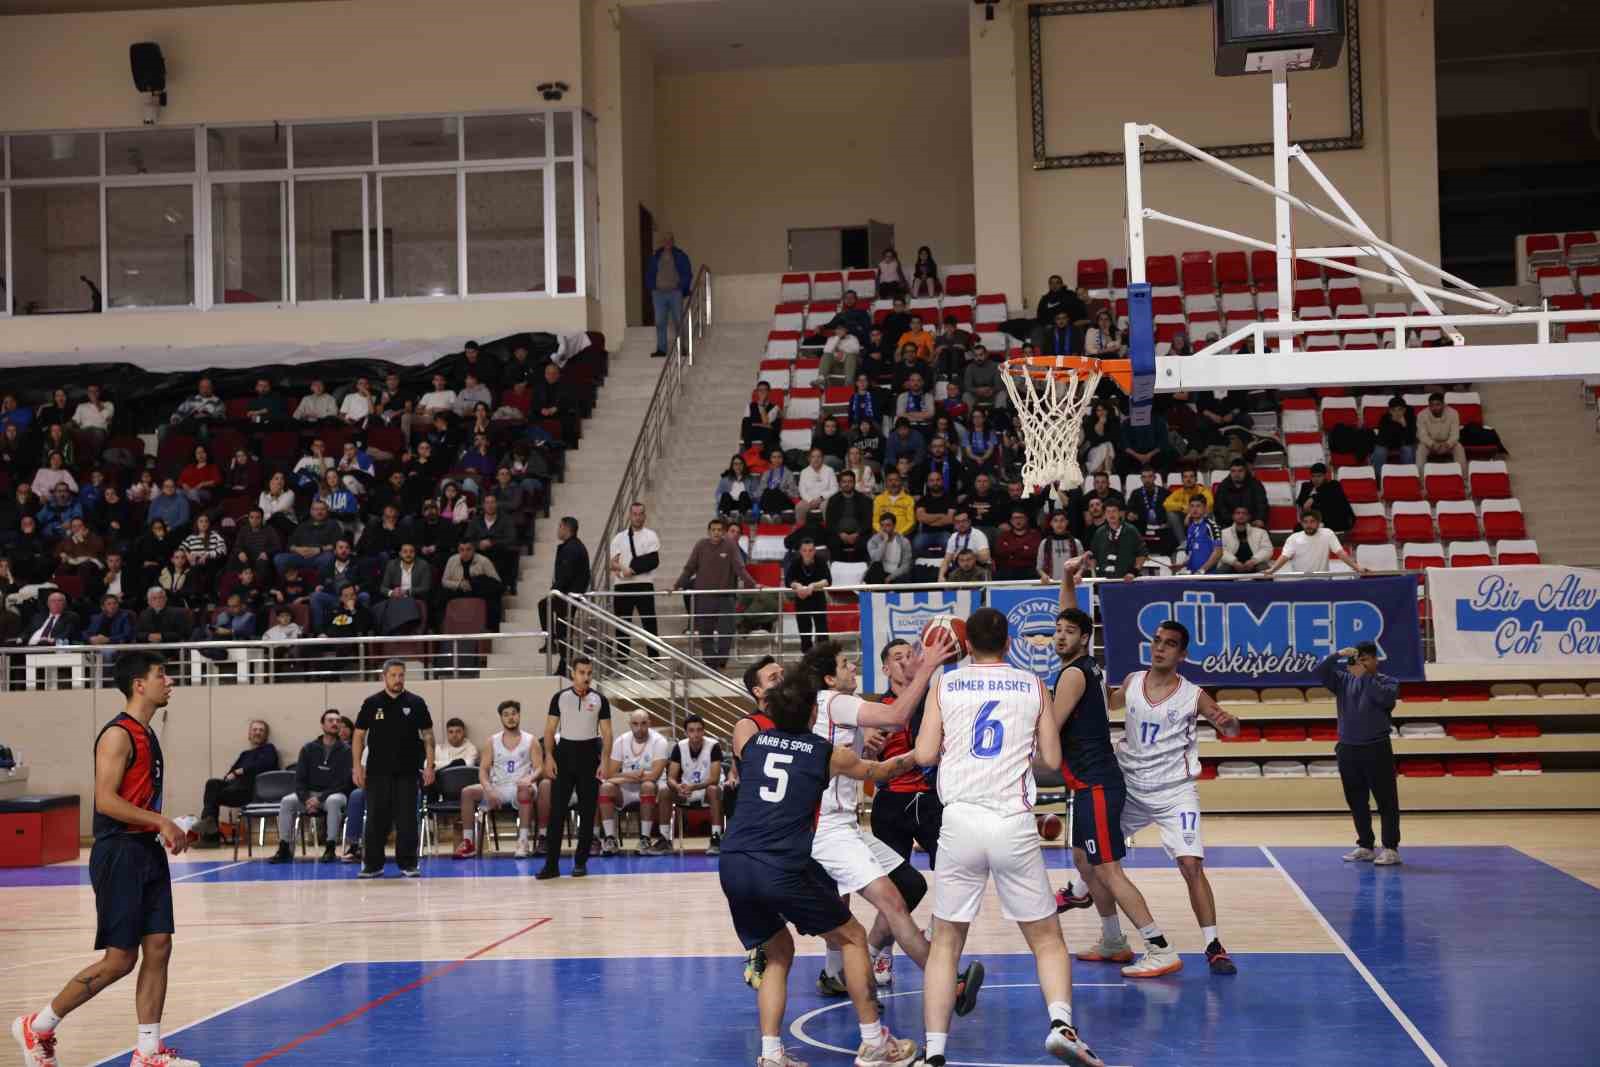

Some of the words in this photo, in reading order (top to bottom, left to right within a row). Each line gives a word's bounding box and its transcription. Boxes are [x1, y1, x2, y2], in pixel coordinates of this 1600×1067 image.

[1473, 574, 1520, 608] Bir
[1538, 573, 1598, 609] Alev
[1137, 591, 1386, 666] SÜMER
[1495, 620, 1541, 658] Çok
[1559, 619, 1600, 655] Sev
[1202, 646, 1318, 678] eskişehir
[988, 680, 1032, 694] BASKET
[969, 700, 1004, 759] 6
[1140, 721, 1160, 744] 17
[790, 740, 814, 754] SPOR
[759, 752, 794, 803] 5
[1180, 811, 1197, 831] 17
